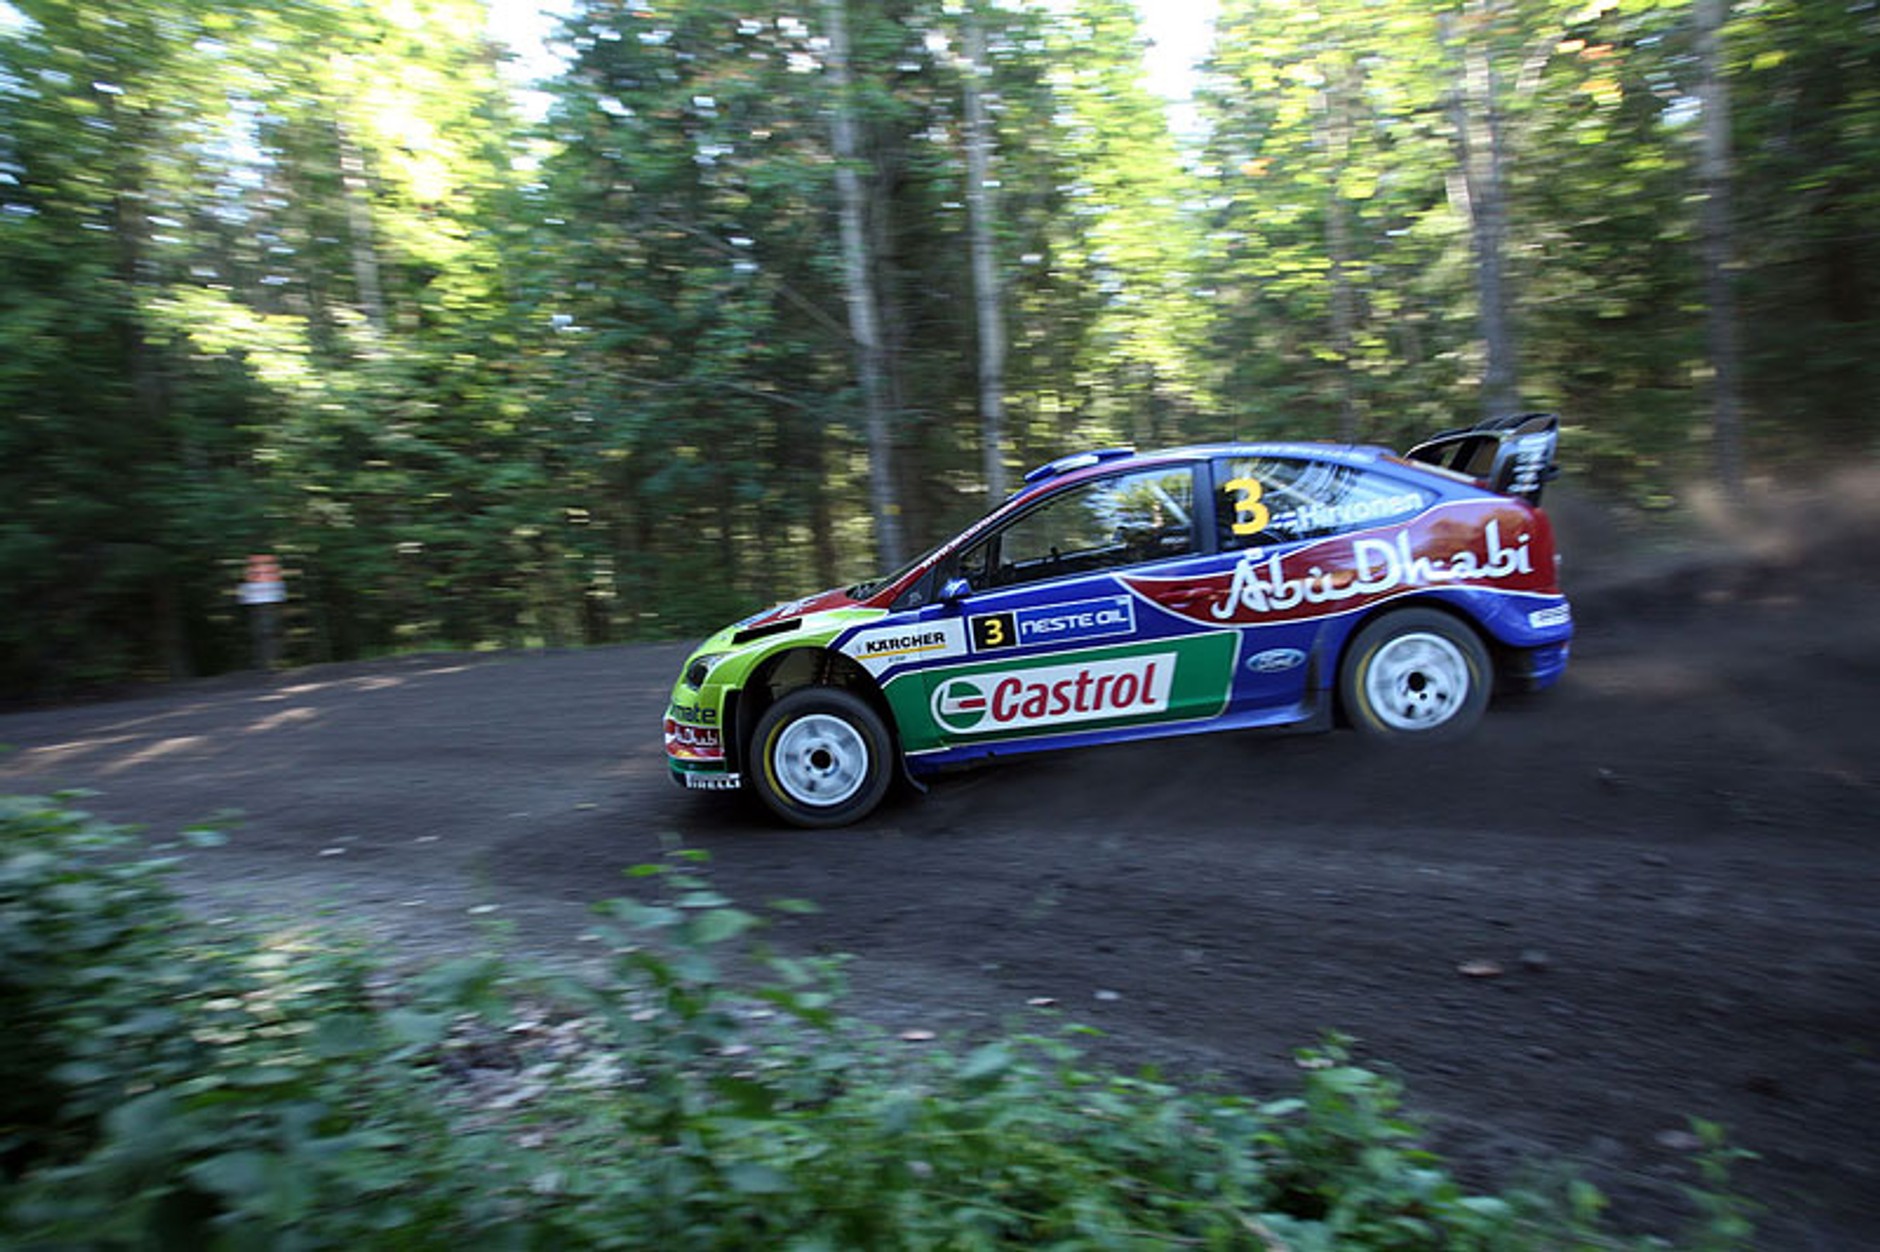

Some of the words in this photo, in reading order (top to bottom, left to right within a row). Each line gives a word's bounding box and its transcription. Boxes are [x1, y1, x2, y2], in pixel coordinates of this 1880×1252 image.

[1224, 477, 1270, 535] 3
[1297, 492, 1424, 532] Hirvonen
[1211, 547, 1344, 620] Abu
[1345, 518, 1534, 596] Dhabi
[984, 618, 1005, 645] 3
[991, 662, 1157, 723] Castrol
